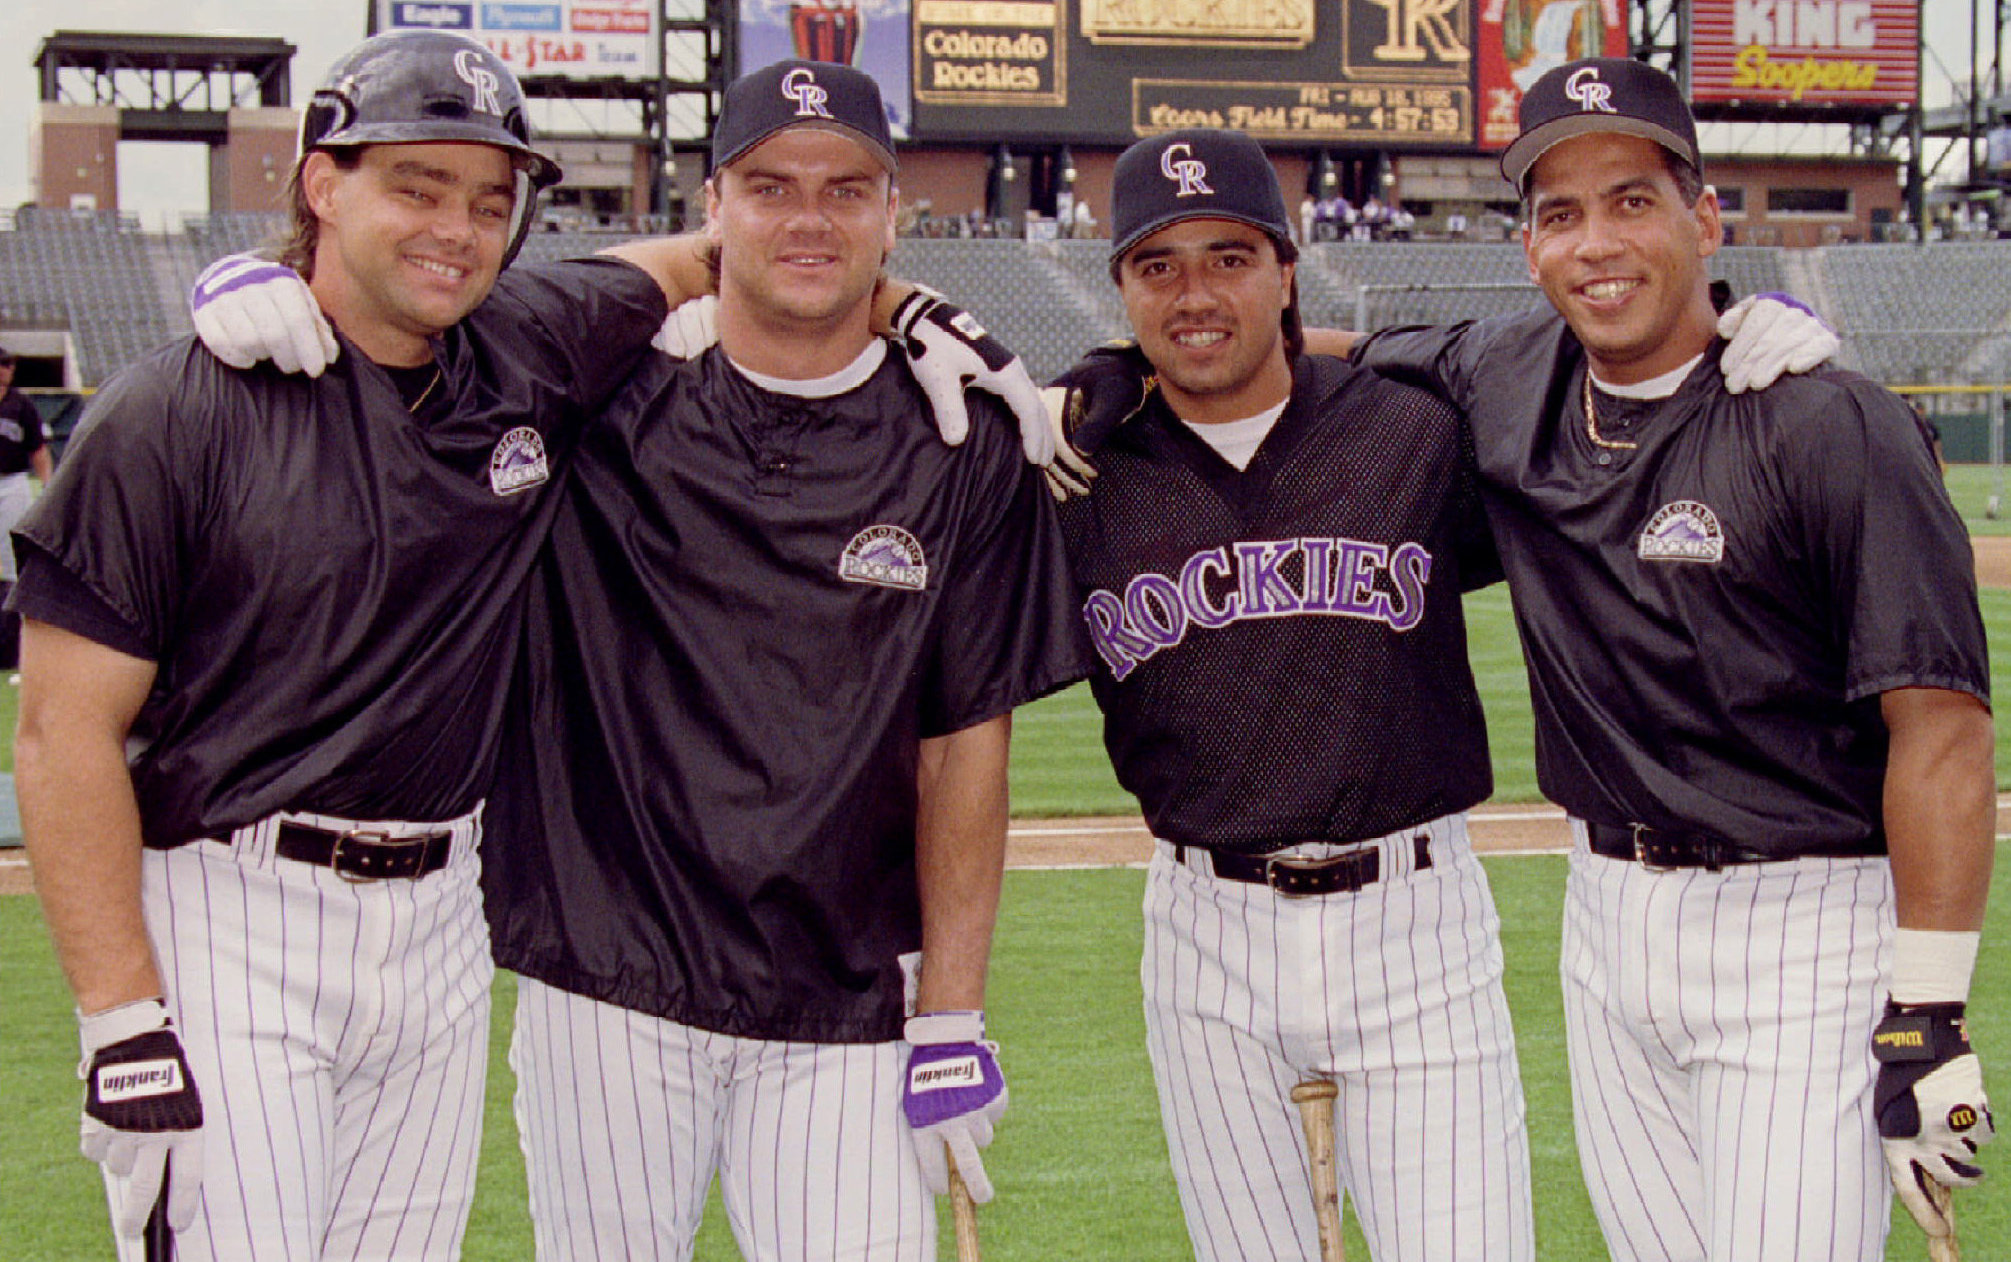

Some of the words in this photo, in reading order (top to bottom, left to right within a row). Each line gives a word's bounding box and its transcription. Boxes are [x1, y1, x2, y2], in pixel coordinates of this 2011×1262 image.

[1734, 0, 1877, 46] KING
[924, 29, 1048, 60] Colorado
[934, 61, 1040, 91] Rockies
[1732, 45, 1880, 101] Soopers
[847, 527, 922, 564] COLORADO
[844, 556, 924, 584] ROCKIES
[1084, 537, 1432, 682] ROCKIES
